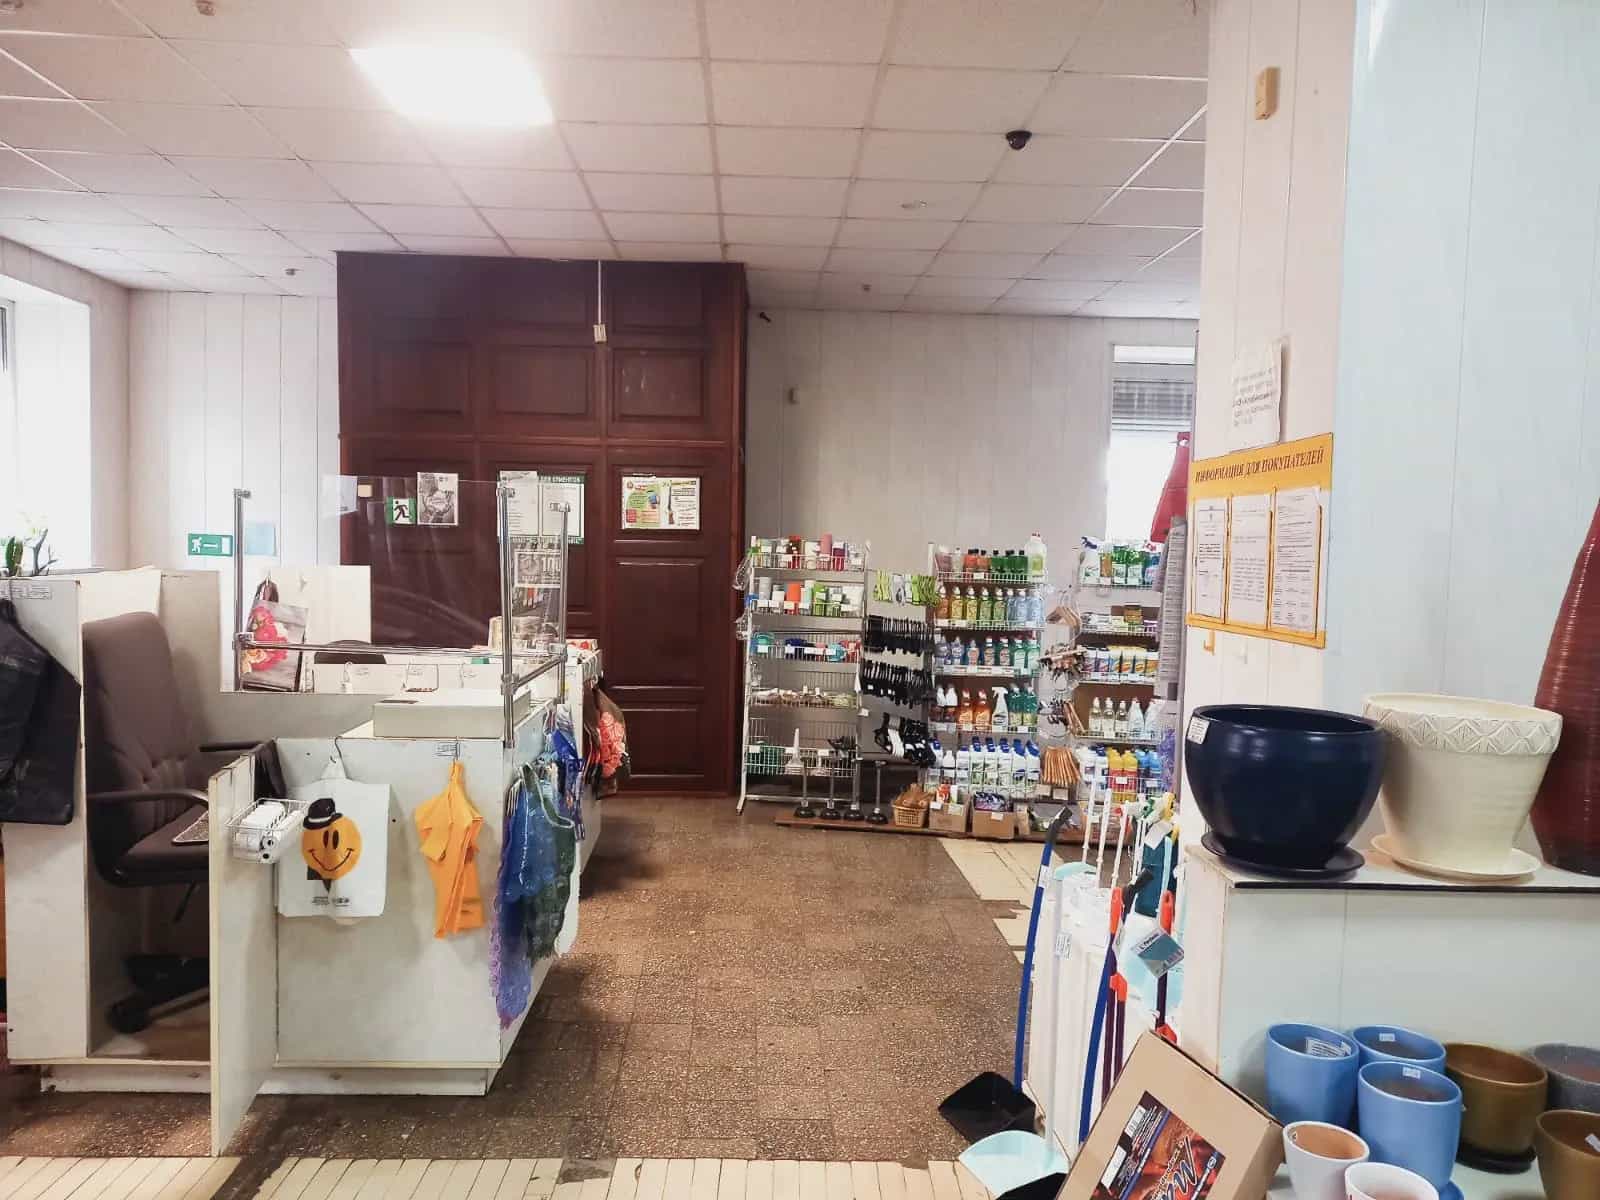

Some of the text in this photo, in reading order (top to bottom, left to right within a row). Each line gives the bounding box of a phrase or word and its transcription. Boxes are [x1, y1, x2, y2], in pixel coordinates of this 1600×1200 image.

[1195, 445, 1325, 483] ИНФОРМАЦИЯ ДЛЯ ПОКУПАТЕЛЕЙ
